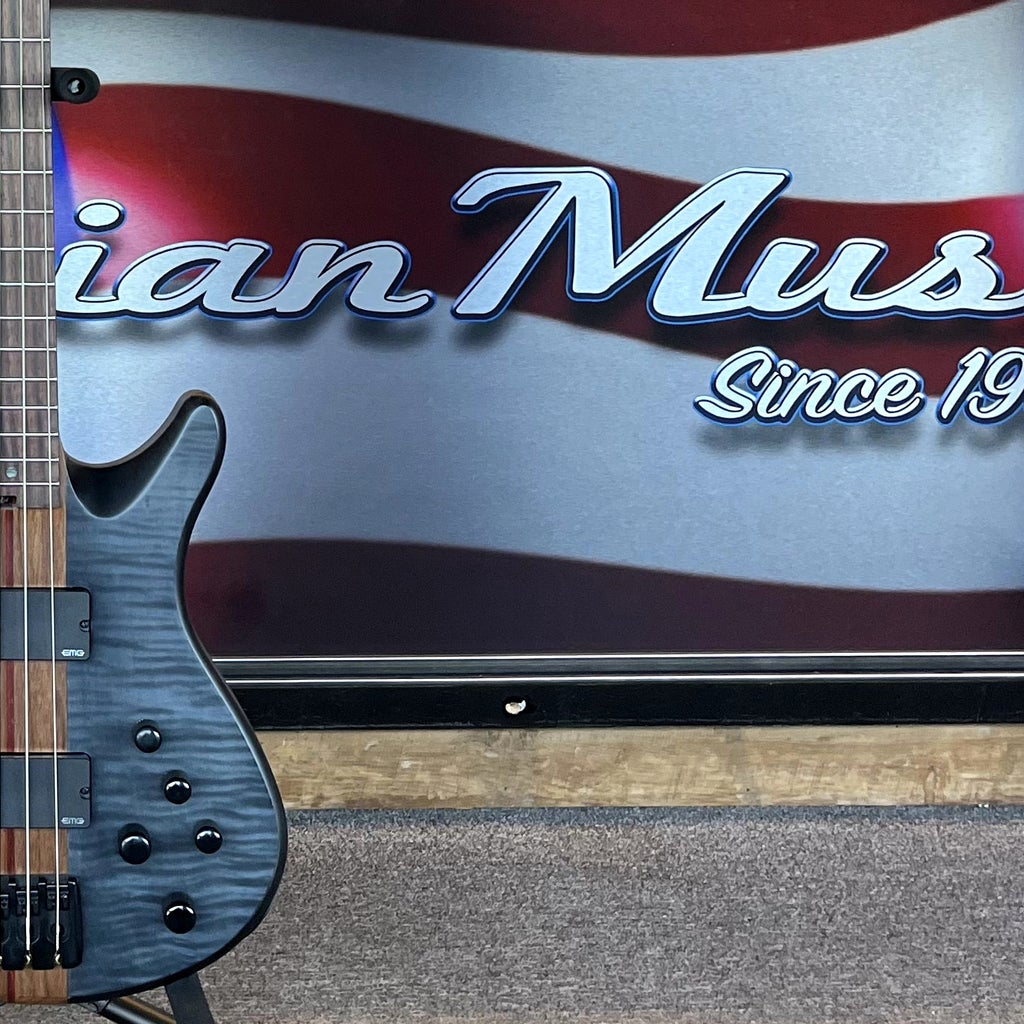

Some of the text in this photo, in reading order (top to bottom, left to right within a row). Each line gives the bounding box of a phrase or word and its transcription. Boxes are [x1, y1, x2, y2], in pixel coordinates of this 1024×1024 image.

[693, 346, 928, 425] Since
[61, 649, 85, 657] EMG
[61, 817, 85, 825] EMG
